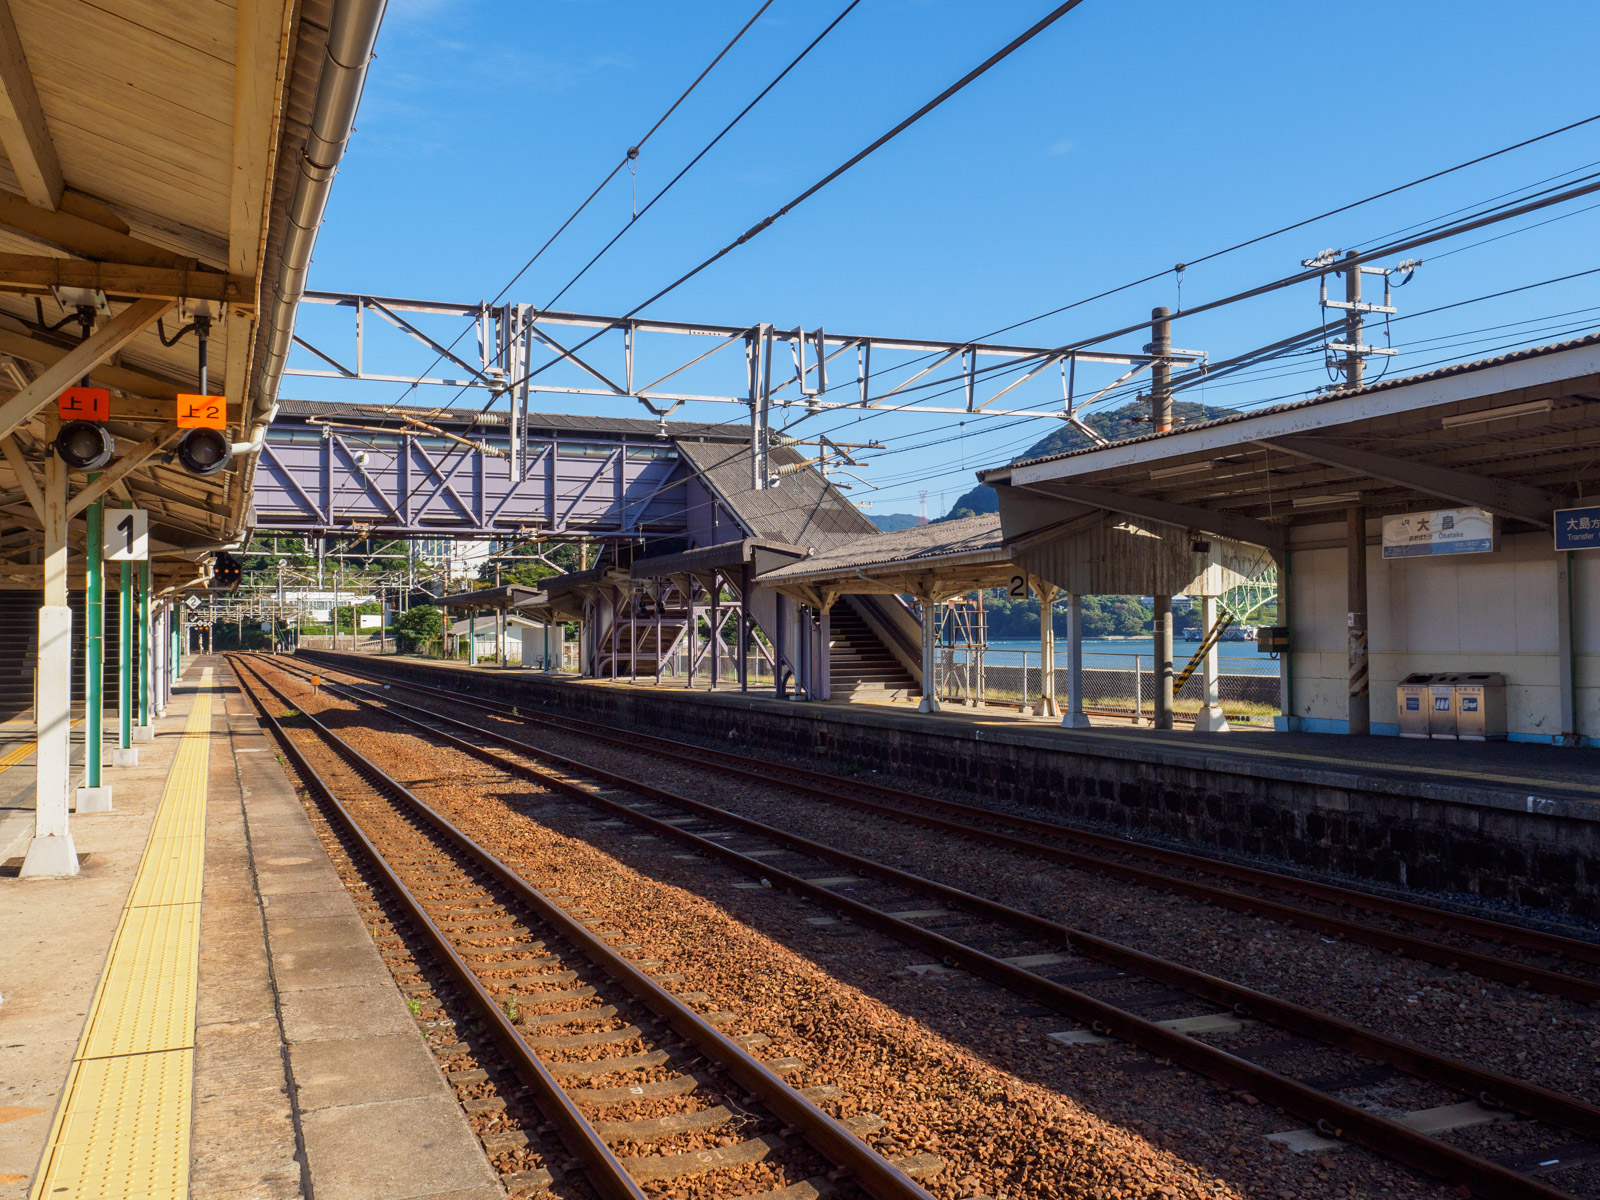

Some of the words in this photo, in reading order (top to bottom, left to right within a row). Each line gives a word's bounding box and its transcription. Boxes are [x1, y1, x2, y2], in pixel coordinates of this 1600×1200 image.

[116, 513, 134, 555] 1
[1567, 532, 1595, 541] Transfer
[1010, 575, 1025, 597] 2
